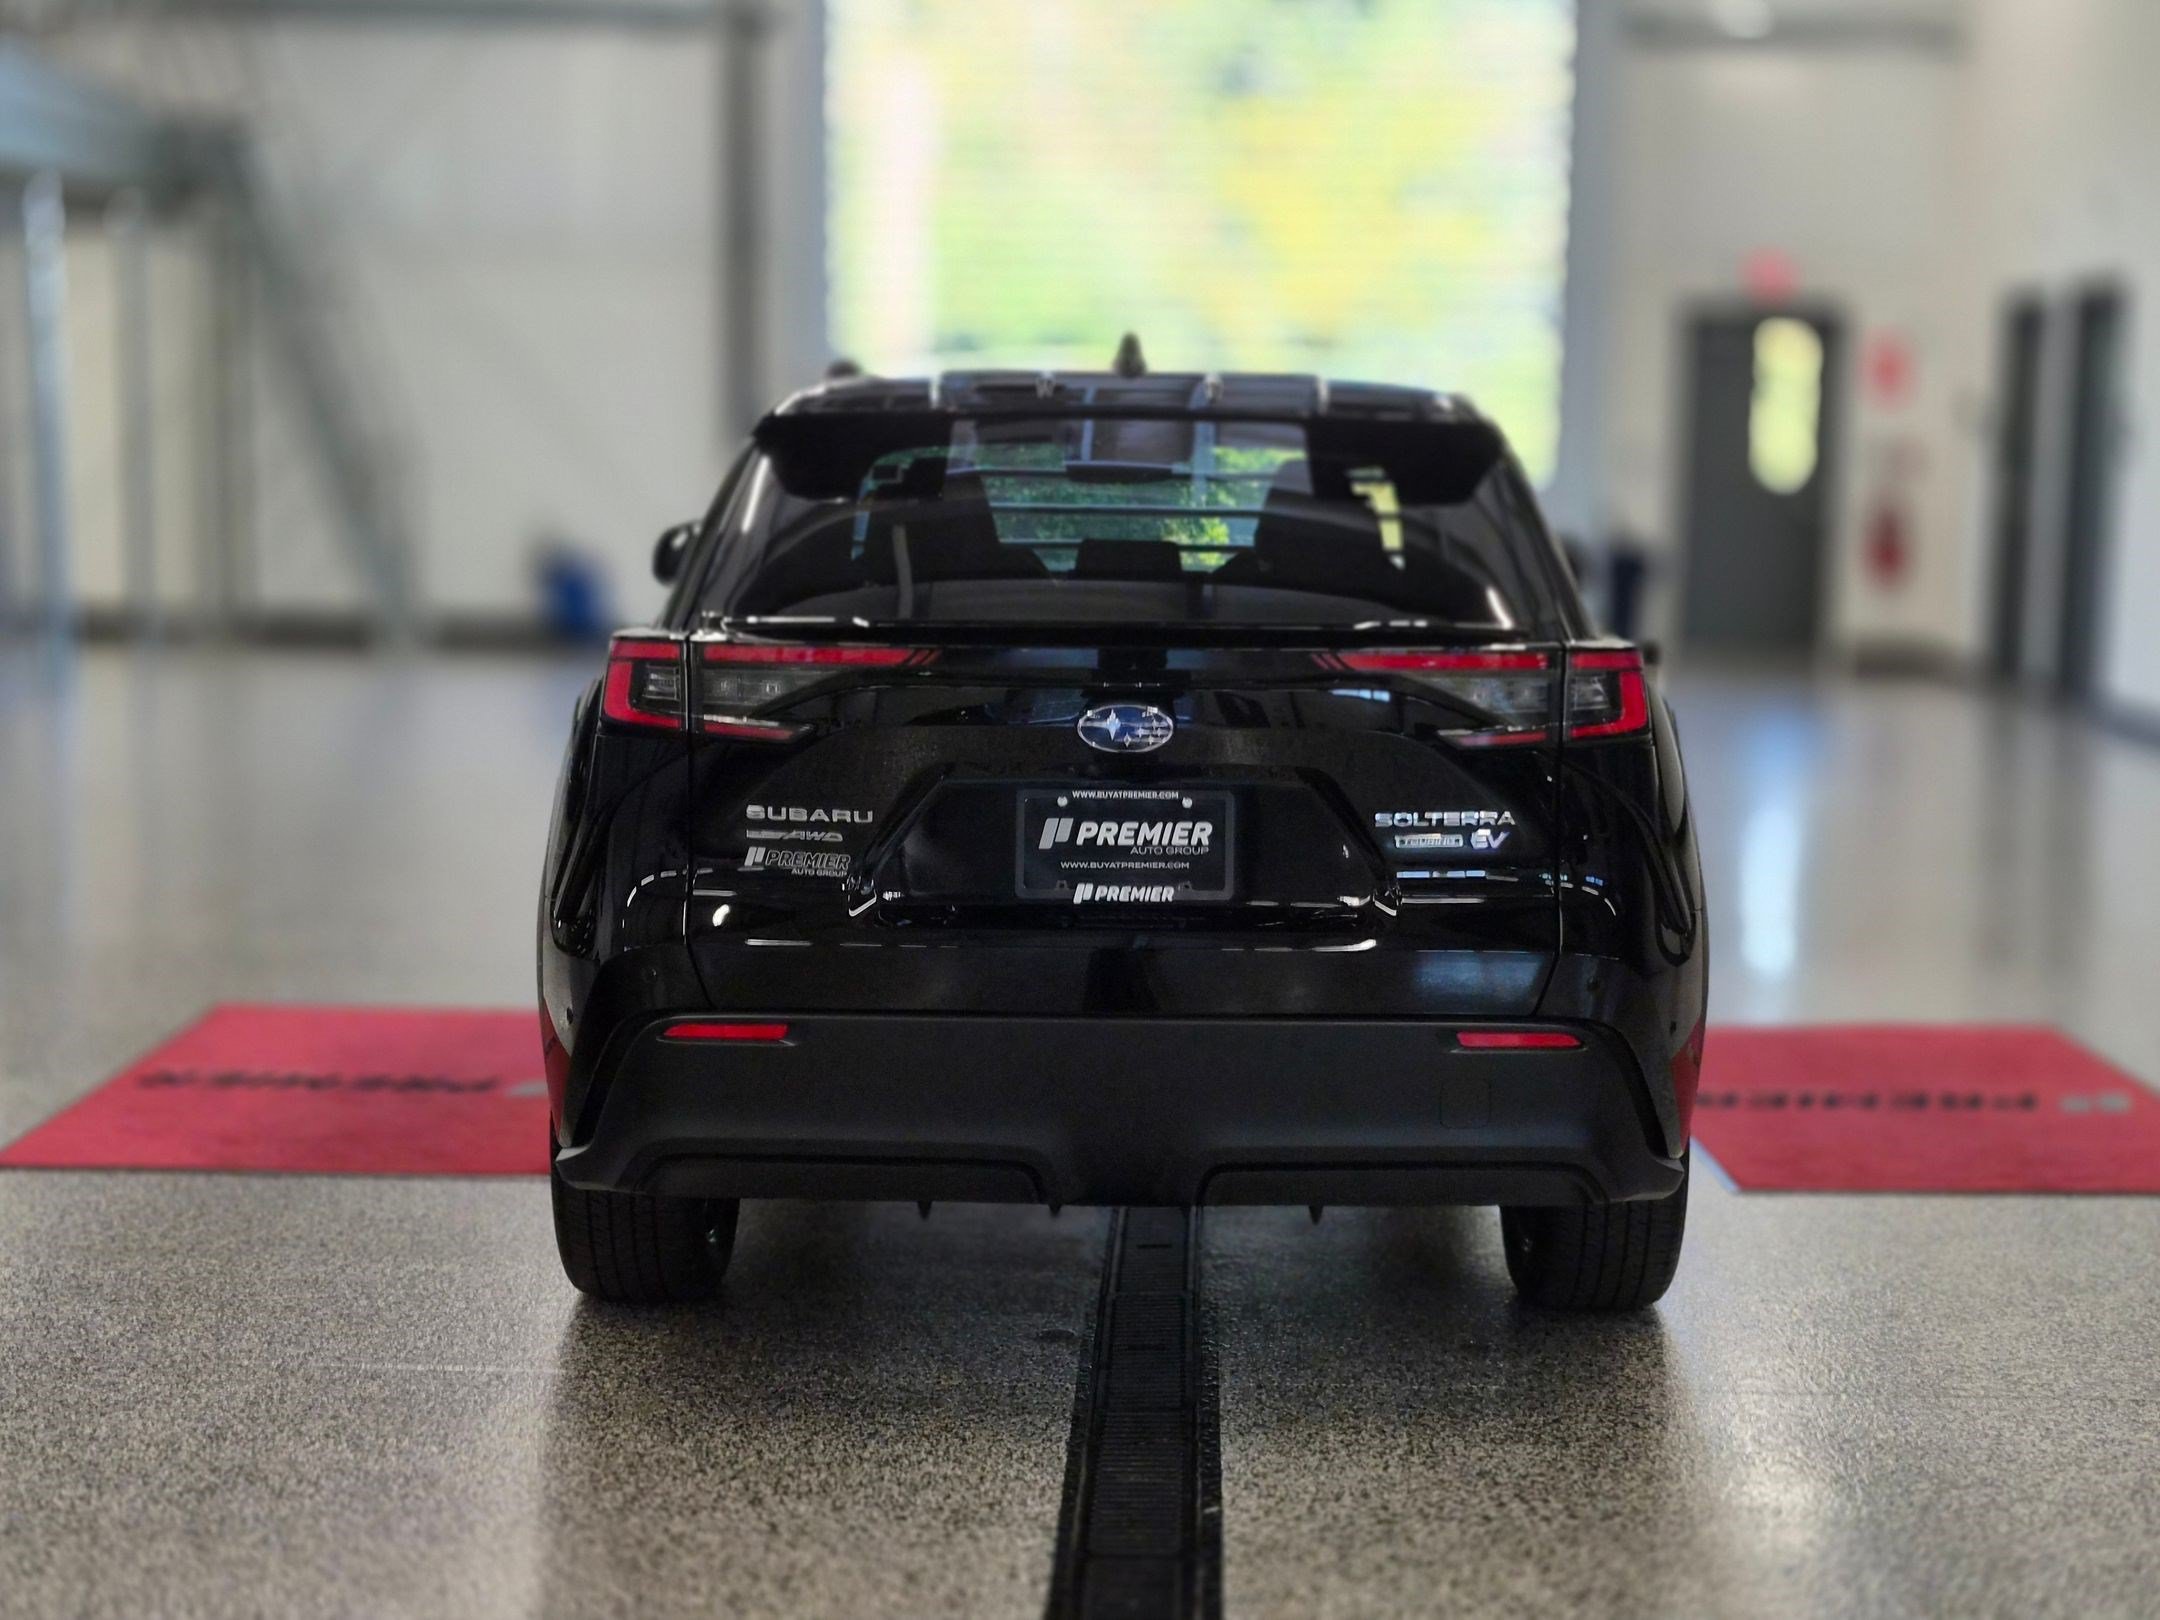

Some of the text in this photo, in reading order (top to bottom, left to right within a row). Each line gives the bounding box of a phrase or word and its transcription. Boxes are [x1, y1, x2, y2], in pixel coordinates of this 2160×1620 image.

[1072, 790, 1179, 800] WWW.BUYATPREMIER.COM
[746, 804, 873, 823] SUBARU
[1375, 810, 1516, 828] SOLTERRA
[1076, 821, 1213, 846] PREMIER
[1470, 828, 1510, 849] EV
[1130, 846, 1210, 856] AUTO GROUP
[765, 850, 851, 871] PREMIER
[1060, 861, 1190, 870] WWW.BUYATPREMIER.COM
[791, 868, 848, 878] AUTO GROUP
[1094, 885, 1175, 903] PREMIER
